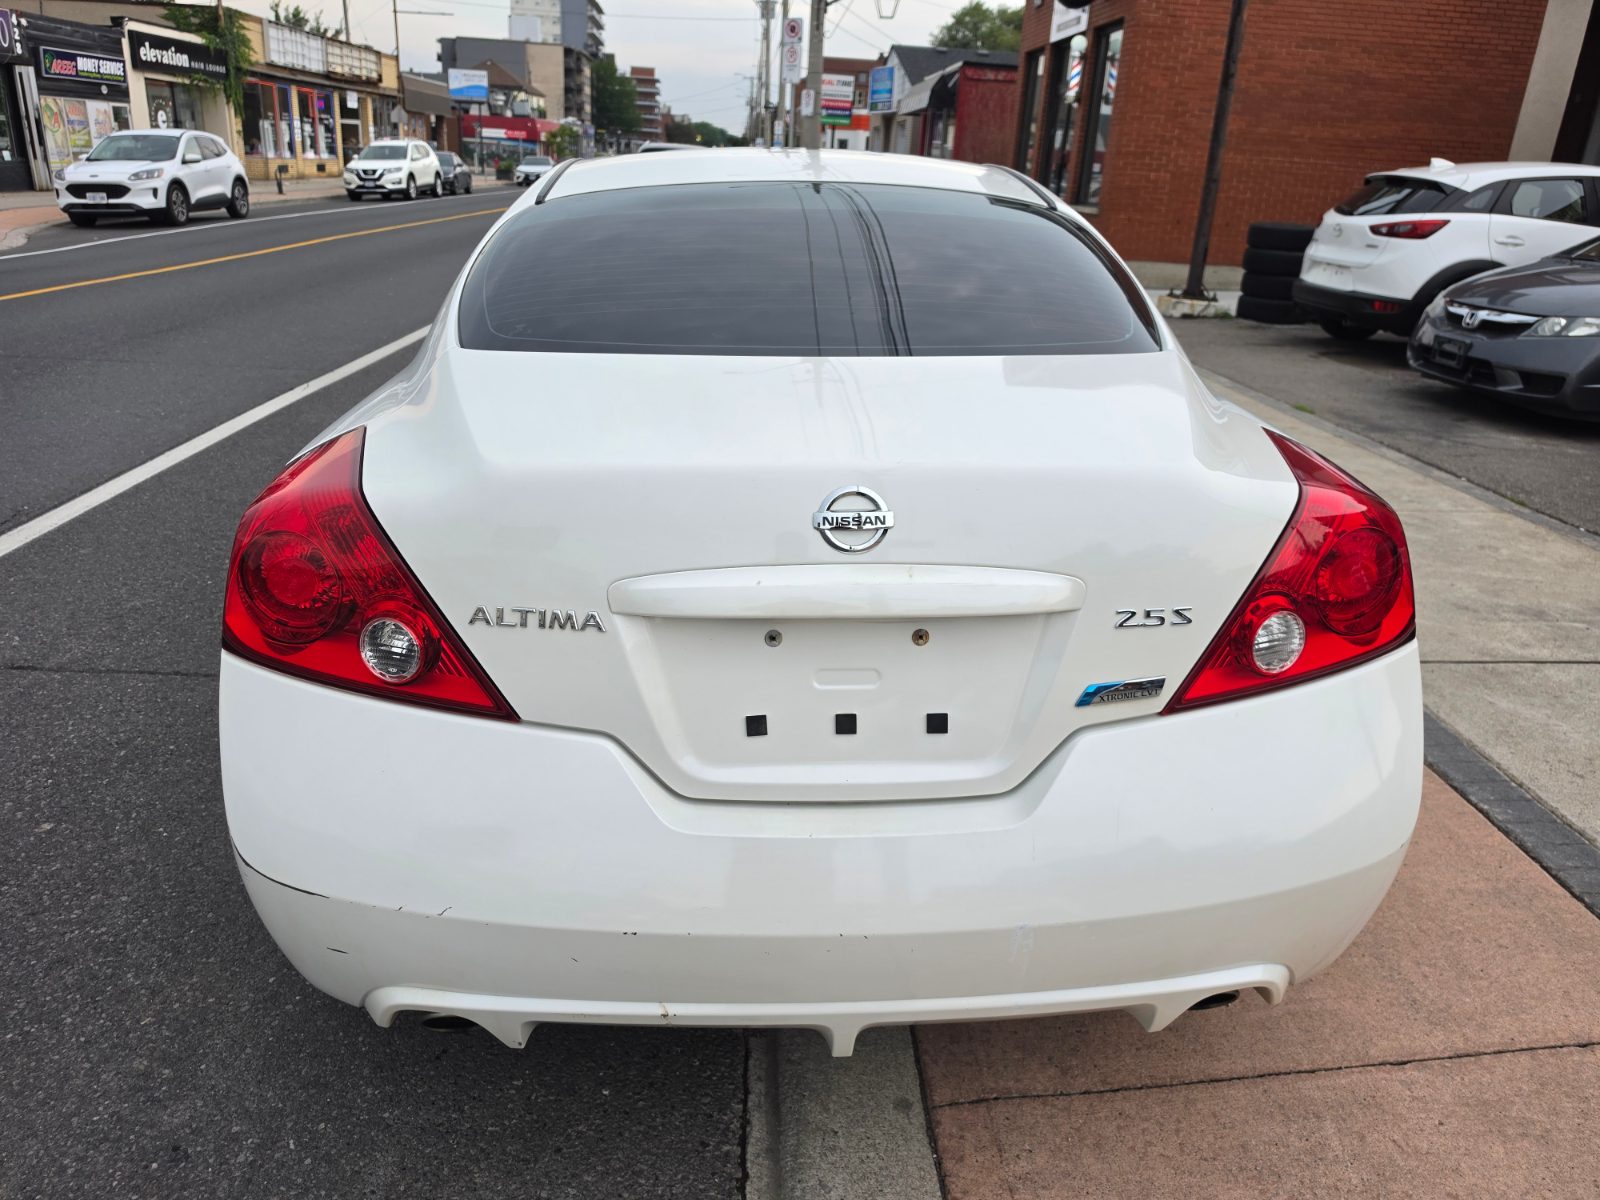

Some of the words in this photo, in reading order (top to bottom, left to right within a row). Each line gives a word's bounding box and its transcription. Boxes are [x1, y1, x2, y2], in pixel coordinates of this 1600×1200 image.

[77, 56, 99, 72] MONEY
[99, 60, 124, 76] SERVICE
[139, 41, 189, 68] elevation
[190, 61, 205, 71] HAIR
[821, 514, 887, 527] NISSAN
[468, 604, 607, 632] ALTIMA
[1099, 690, 1140, 702] XTRONIC
[1141, 688, 1159, 699] CVT
